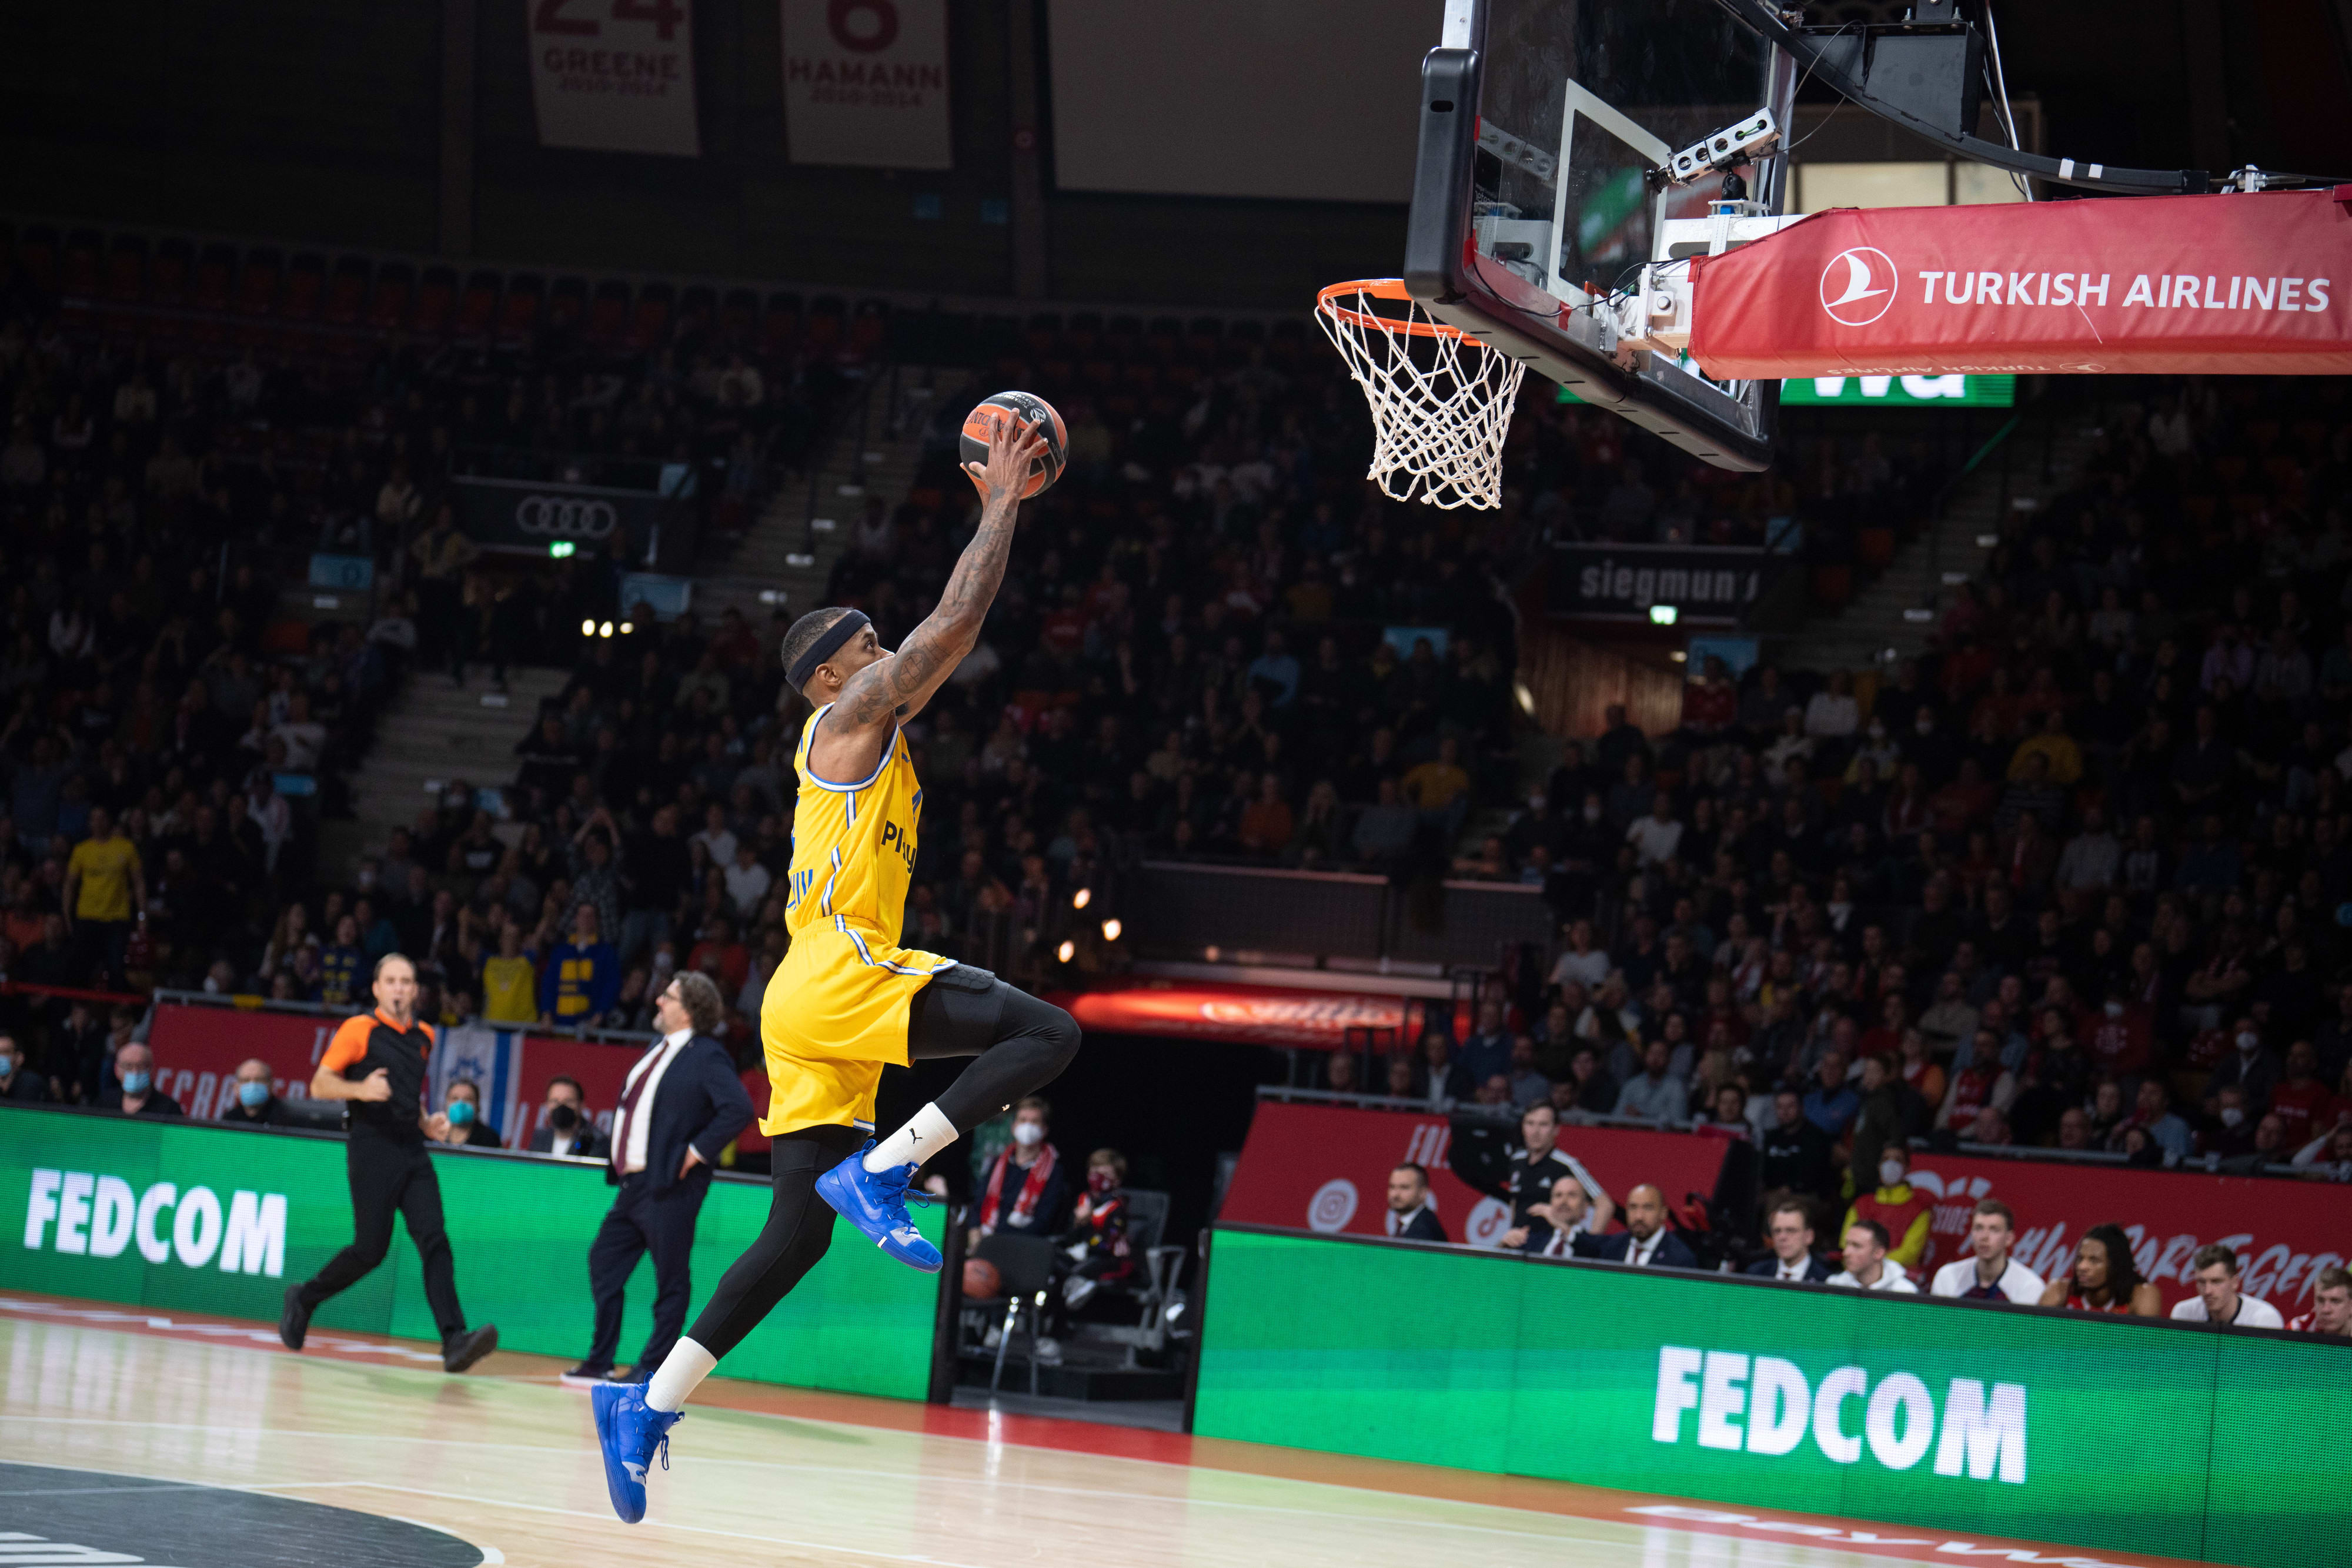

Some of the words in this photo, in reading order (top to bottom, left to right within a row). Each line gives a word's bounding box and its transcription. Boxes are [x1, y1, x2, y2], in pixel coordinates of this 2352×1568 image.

[544, 46, 679, 80] GREENE
[789, 58, 941, 88] HAMANN
[1919, 271, 2110, 306] TURKISH
[2122, 274, 2330, 312] AIRLINES
[1826, 366, 1933, 375] AIRLINES
[24, 1167, 288, 1278] FEDCOM
[1651, 1345, 2027, 1485] FEDCOM
